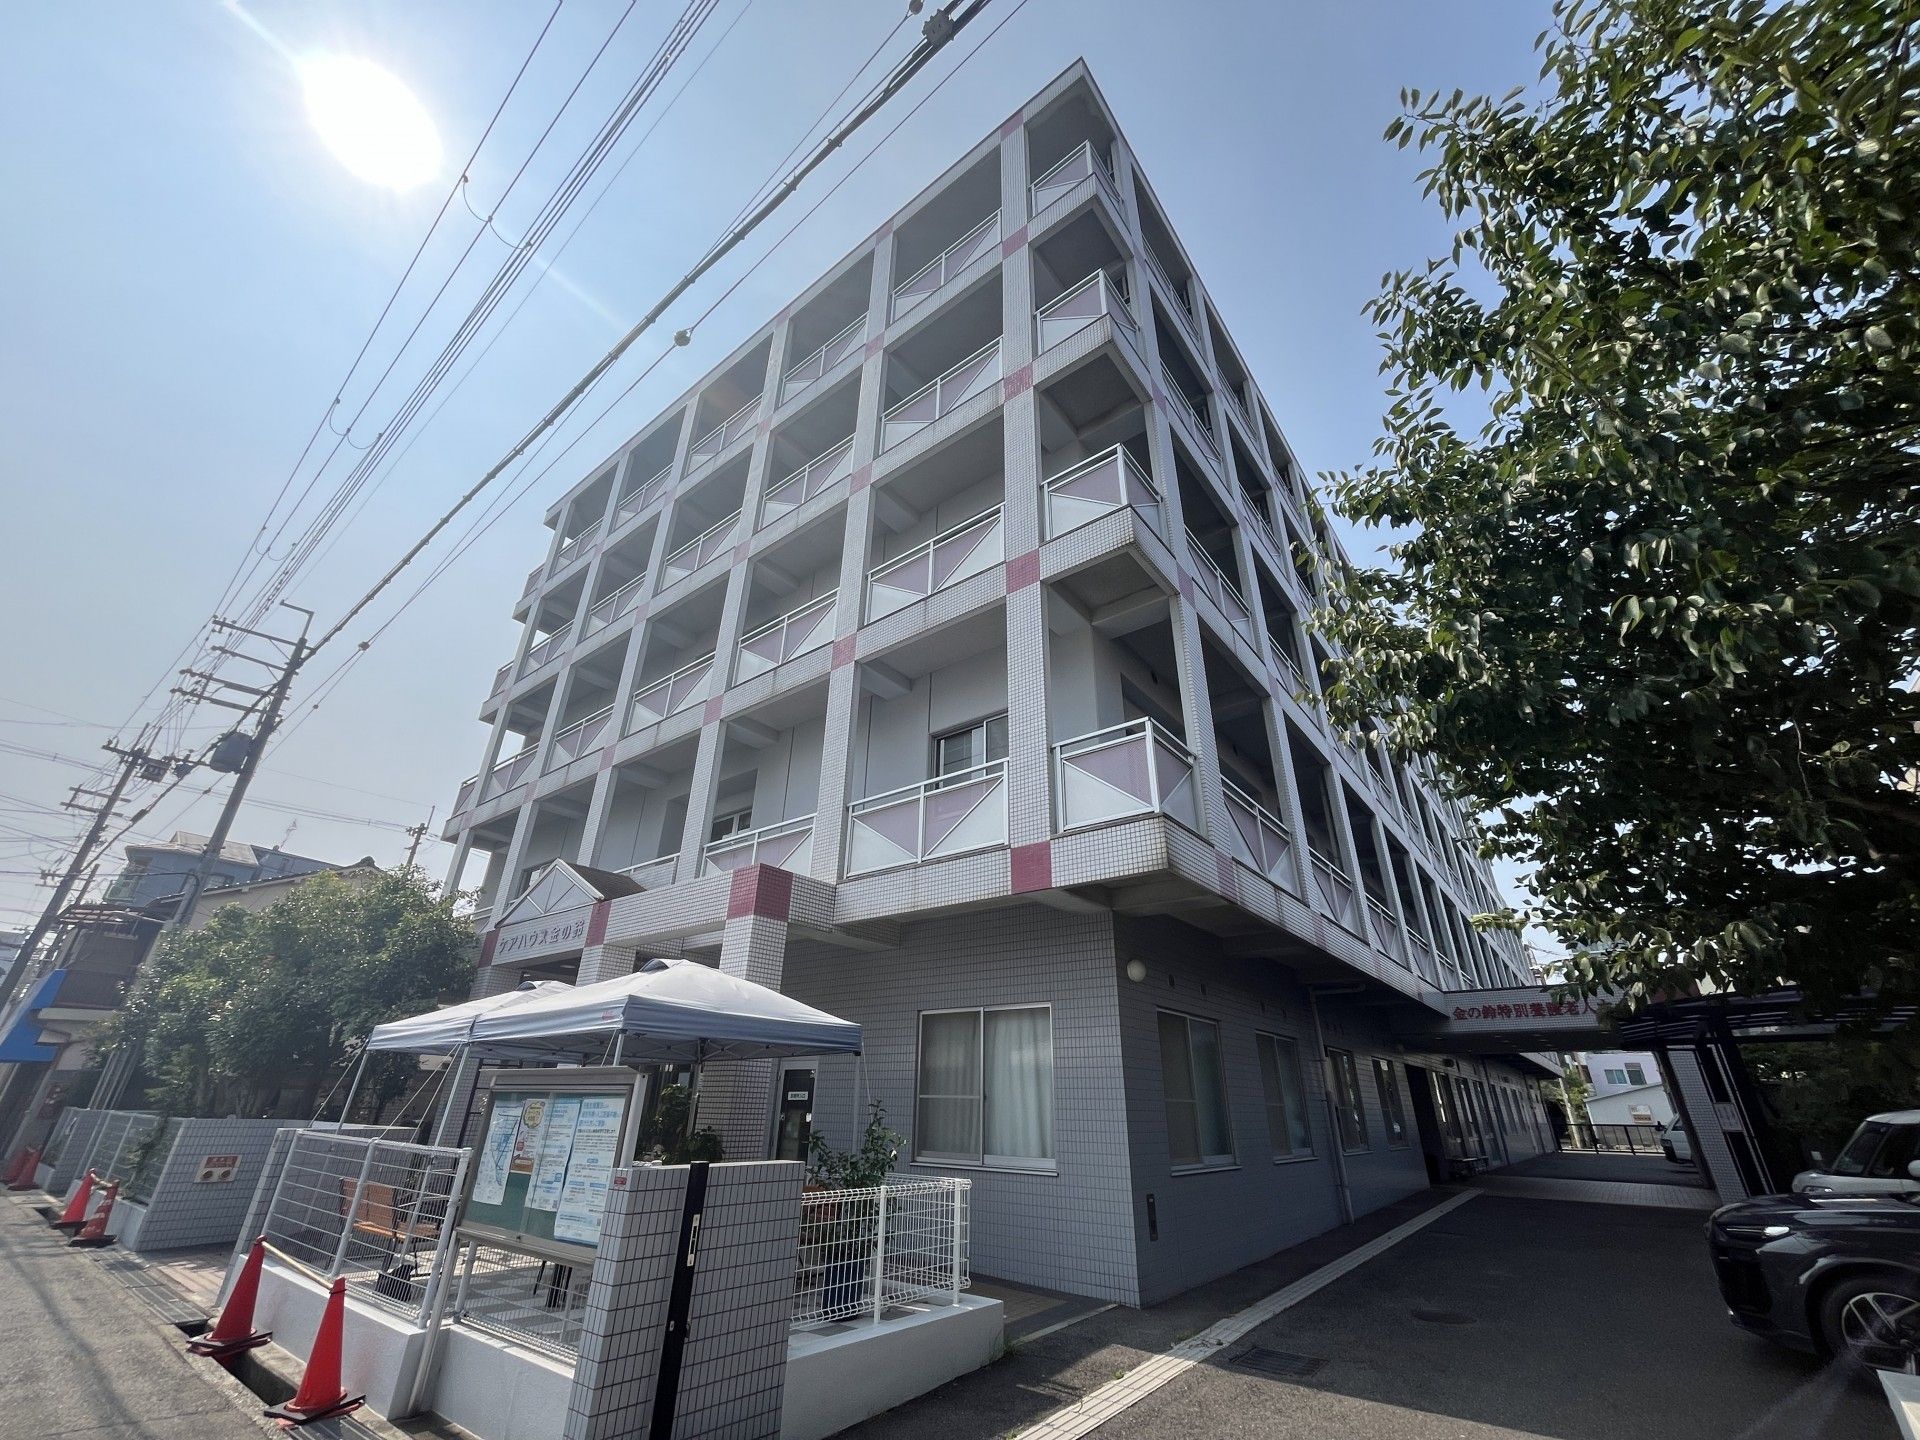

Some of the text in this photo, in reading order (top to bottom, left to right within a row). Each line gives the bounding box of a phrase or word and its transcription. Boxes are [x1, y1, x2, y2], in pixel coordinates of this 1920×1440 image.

[499, 919, 585, 953] ケアハウス金の鈴
